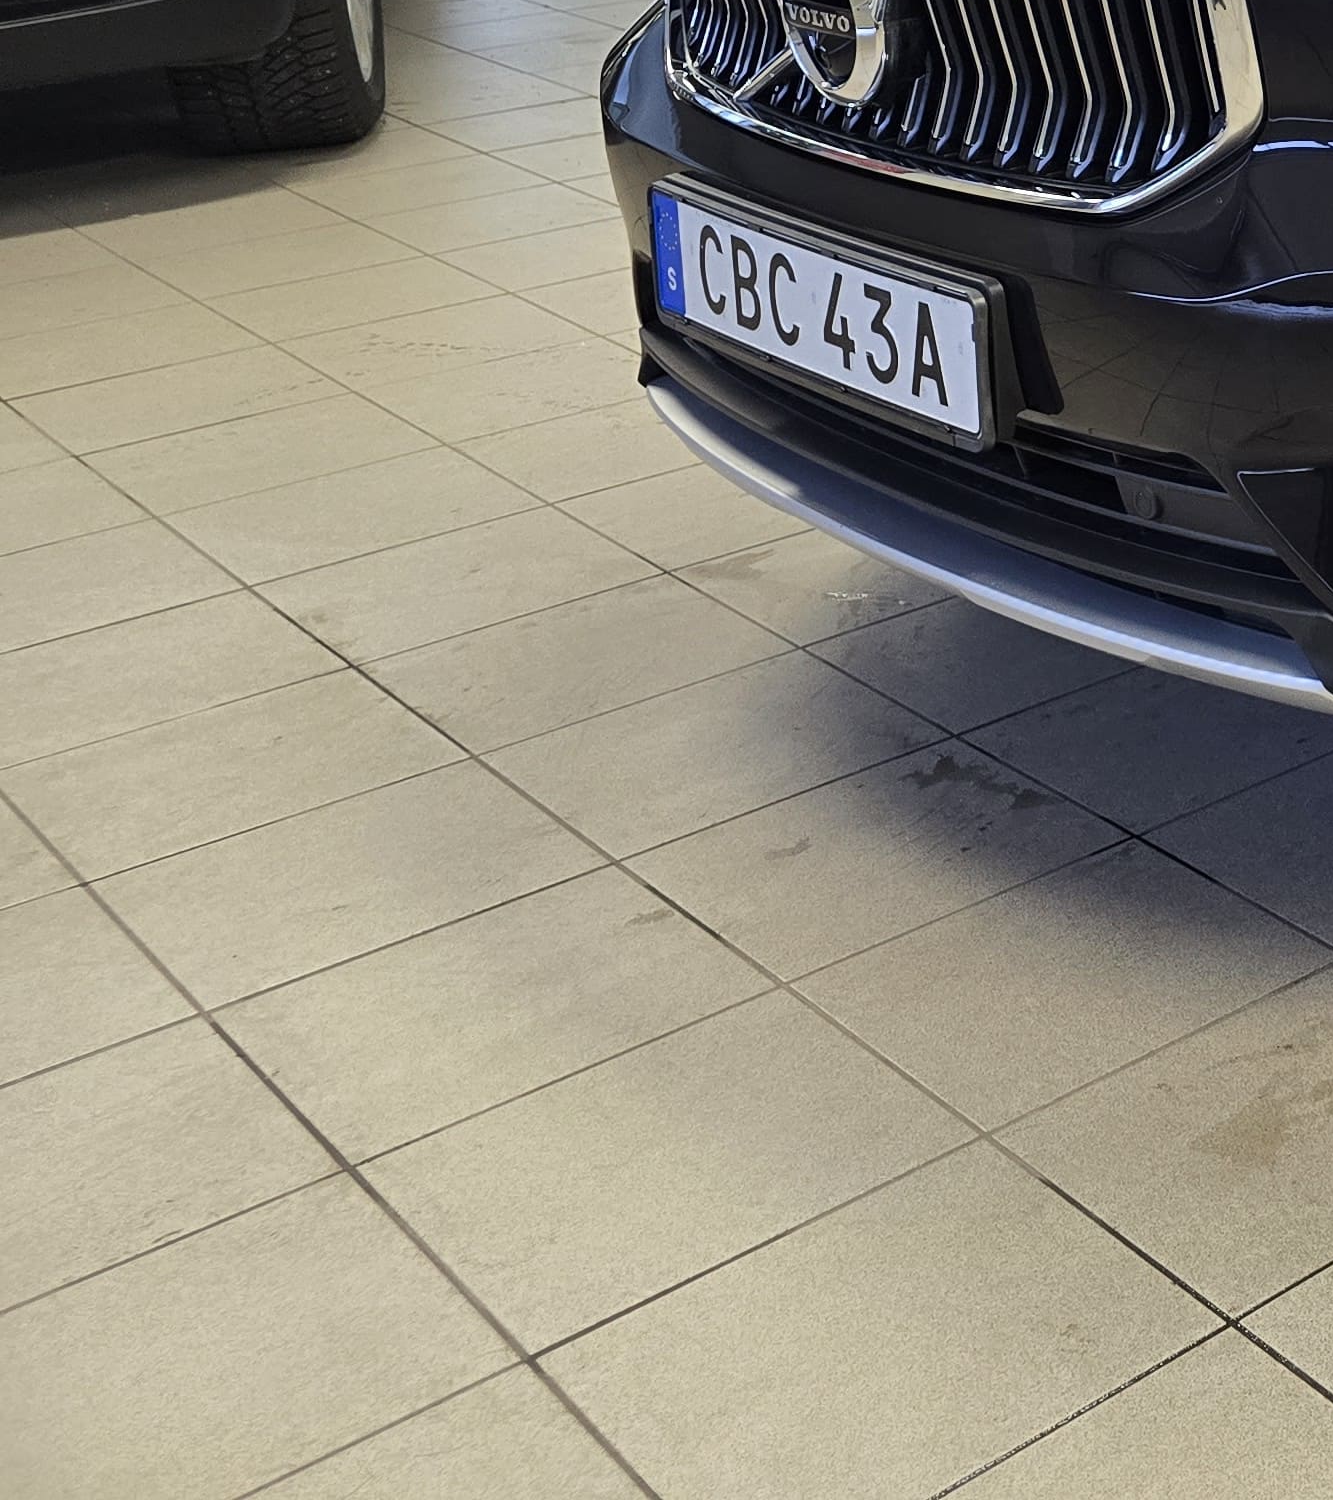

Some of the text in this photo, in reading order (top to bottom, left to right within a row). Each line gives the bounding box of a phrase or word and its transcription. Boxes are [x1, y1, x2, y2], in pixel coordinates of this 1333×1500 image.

[784, 2, 850, 33] VOLVO
[667, 266, 678, 291] S
[699, 224, 949, 408] CBC 43A
